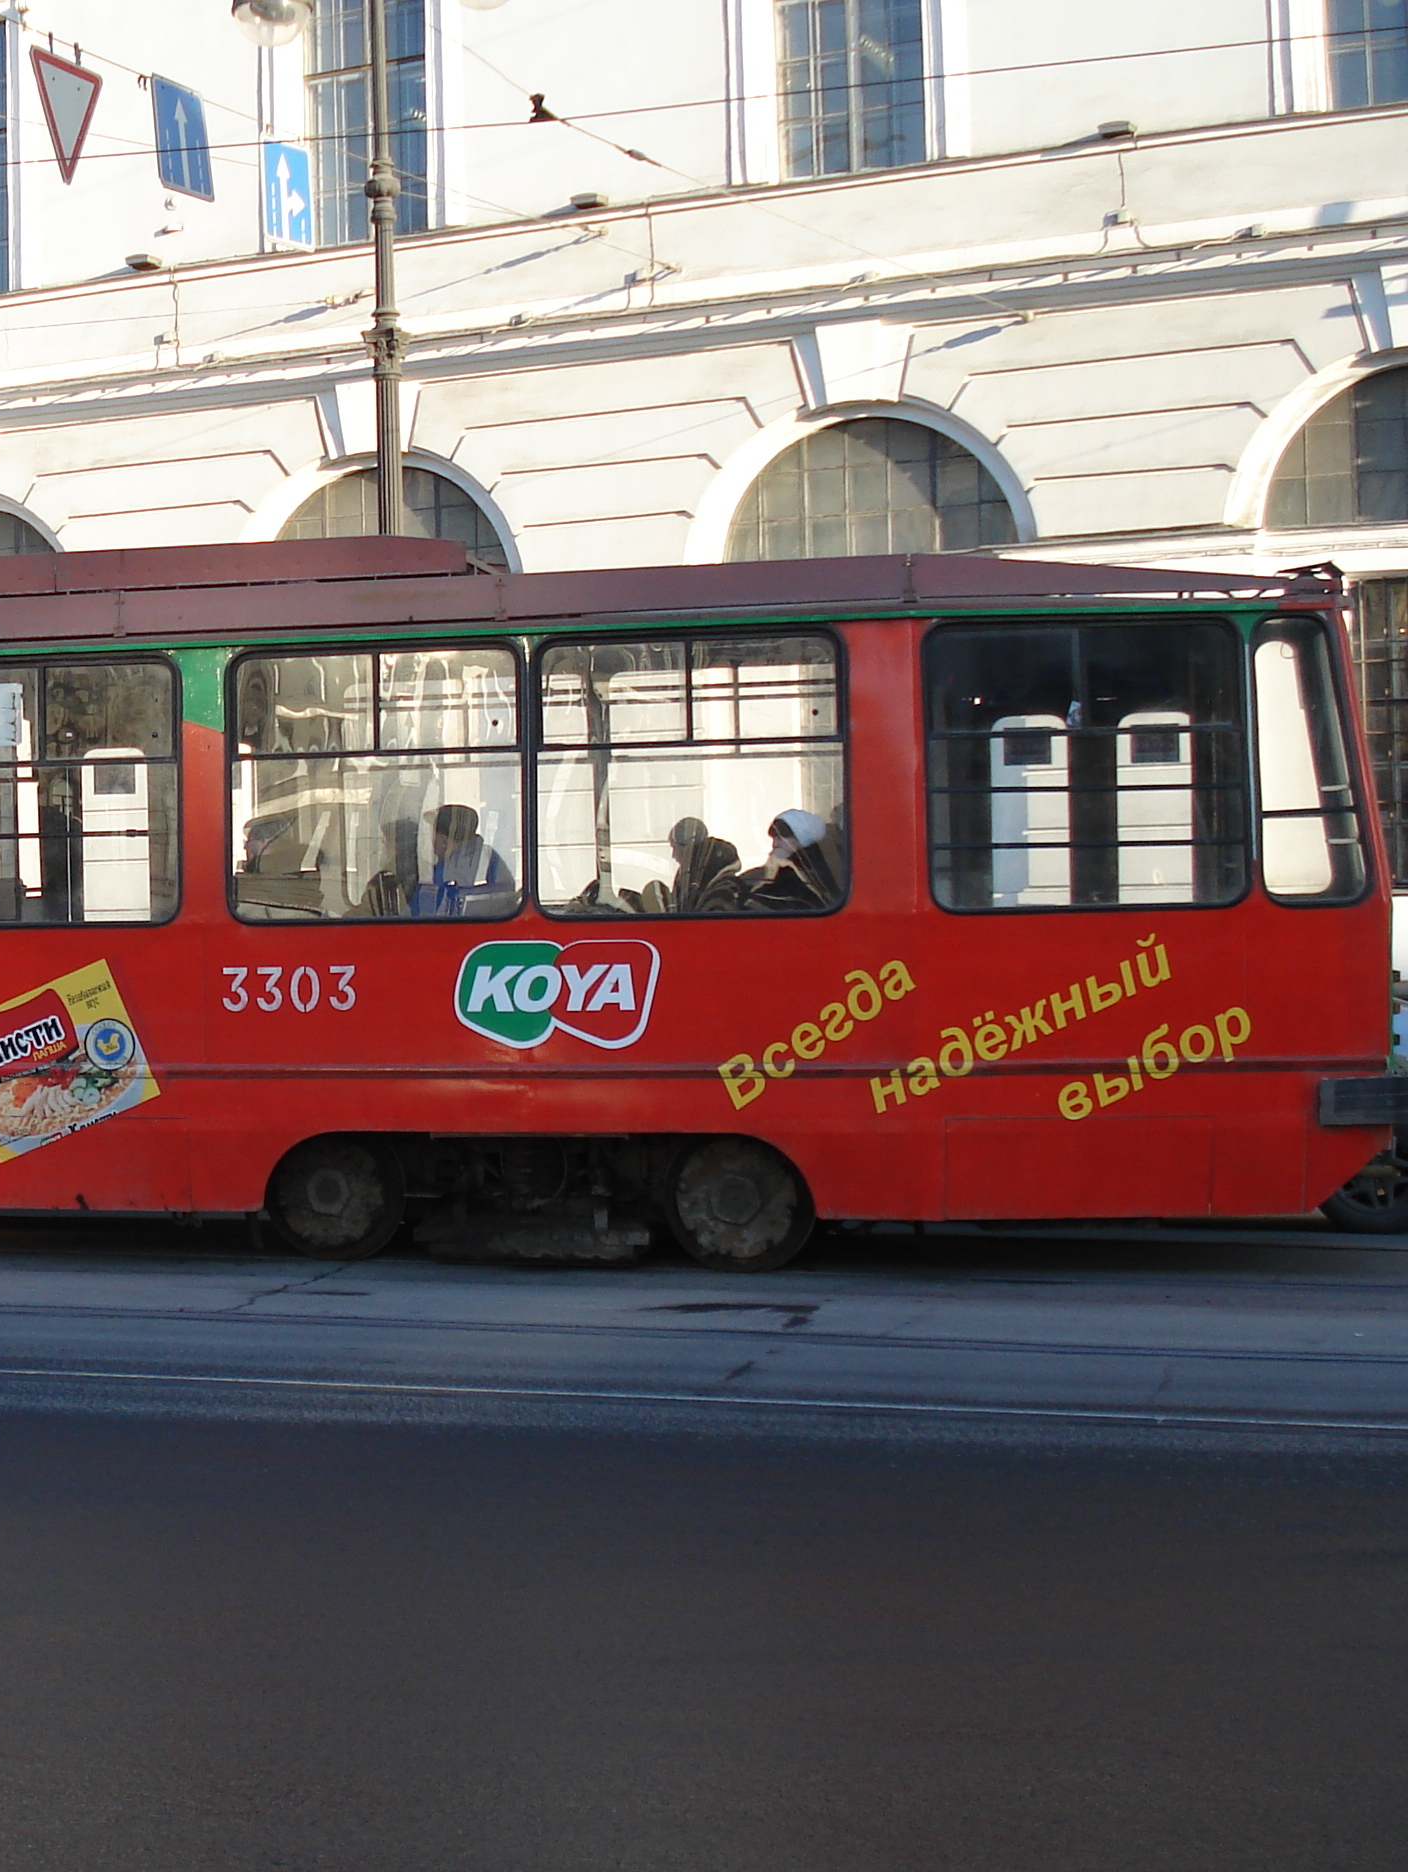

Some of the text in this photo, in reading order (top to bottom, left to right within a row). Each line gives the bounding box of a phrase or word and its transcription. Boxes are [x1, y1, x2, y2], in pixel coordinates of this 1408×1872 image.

[222, 966, 356, 1012] 3303
[467, 964, 636, 1012] KOYA
[870, 934, 1172, 1113] надёжный
[33, 1041, 67, 1061] ЛАПША
[718, 960, 916, 1110] Всегда
[1057, 1006, 1251, 1120] выбор
